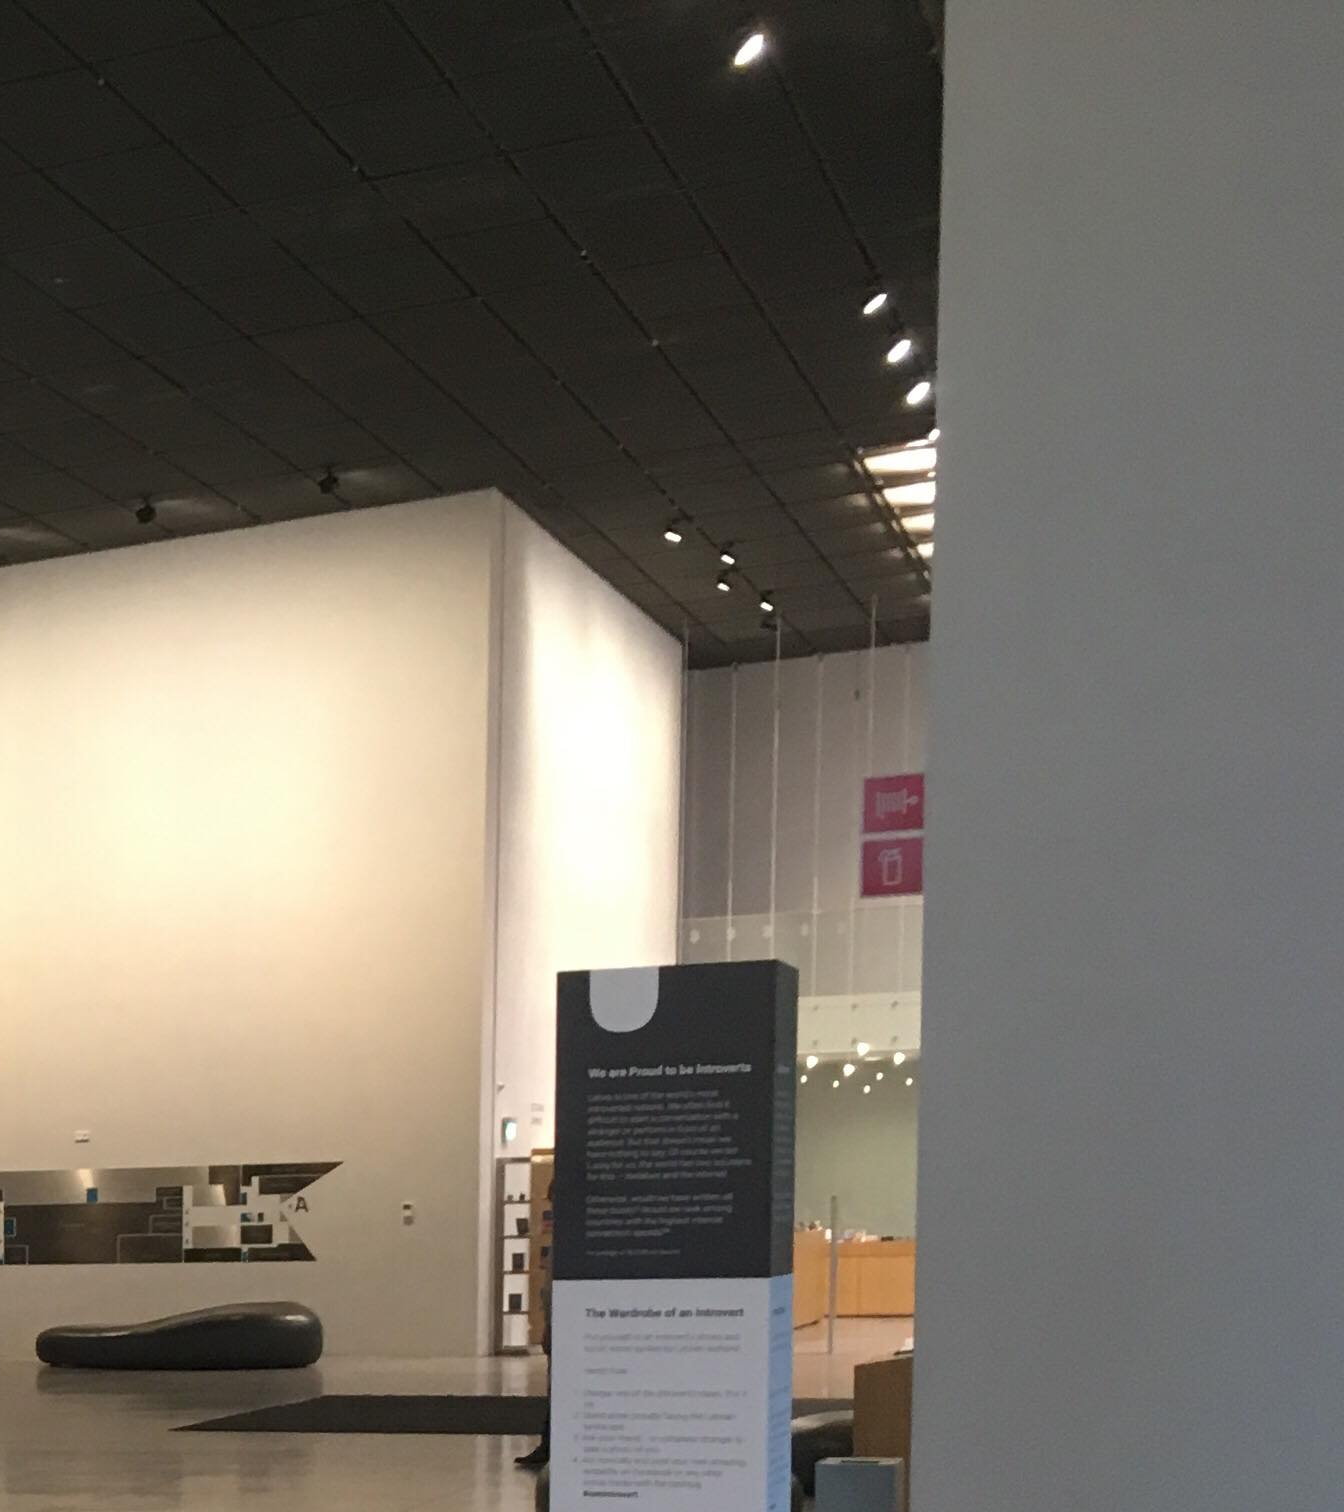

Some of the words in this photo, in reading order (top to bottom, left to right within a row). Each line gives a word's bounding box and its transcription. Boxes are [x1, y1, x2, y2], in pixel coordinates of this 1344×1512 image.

[587, 1068, 606, 1078] We
[609, 1068, 627, 1078] are
[628, 1065, 663, 1077] Proud
[665, 1065, 677, 1076] to
[679, 1064, 694, 1075] be
[295, 1196, 309, 1213] A
[586, 1308, 606, 1318] The
[609, 1308, 661, 1318] Wardrobe
[664, 1307, 677, 1318] of
[679, 1308, 693, 1318] an
